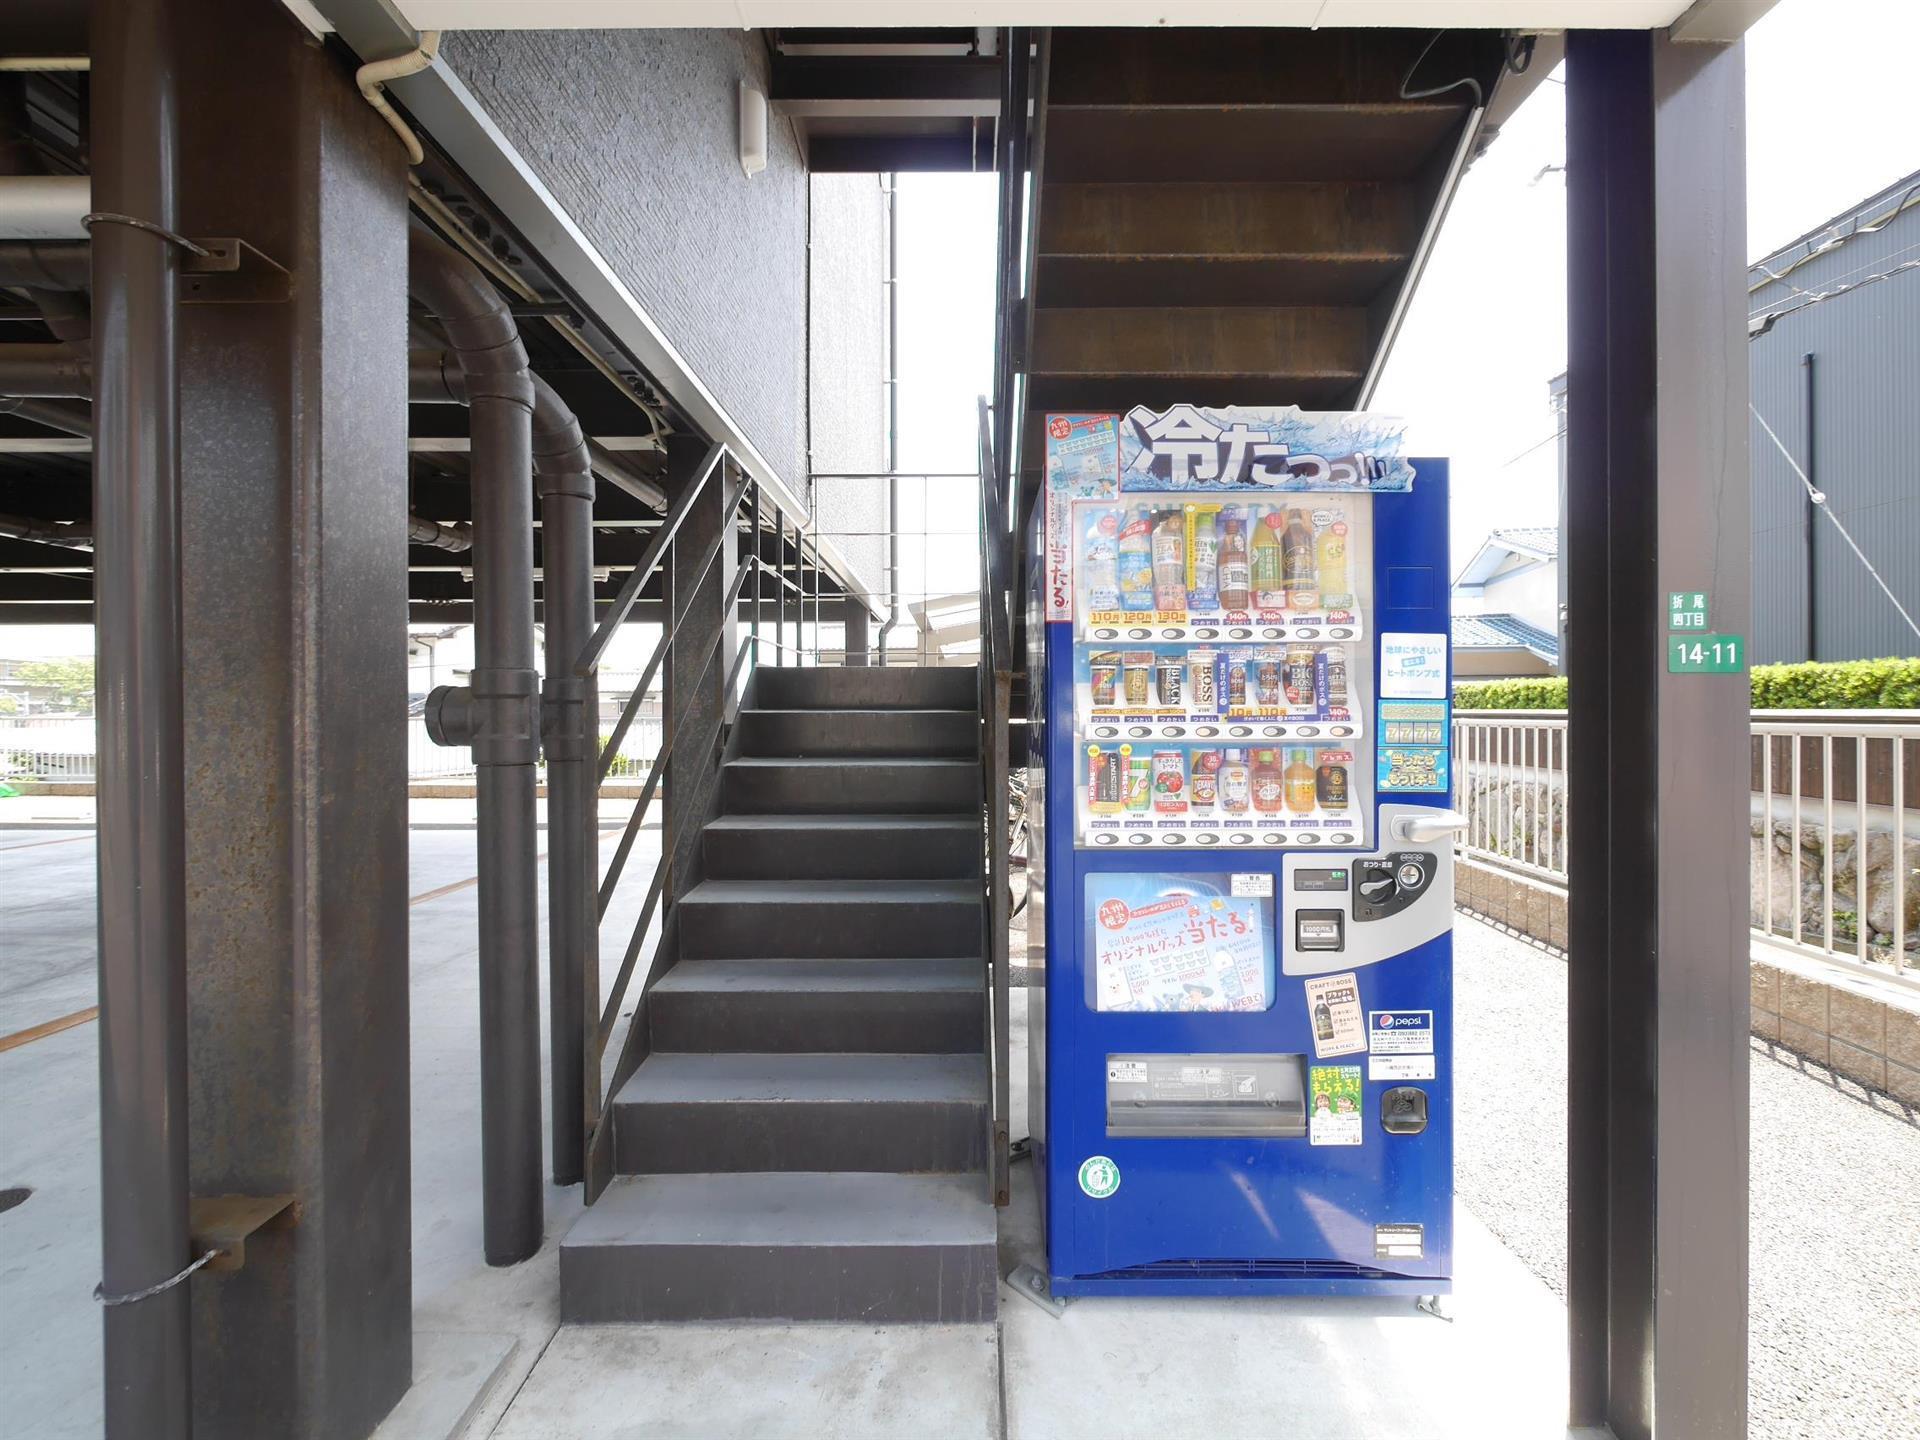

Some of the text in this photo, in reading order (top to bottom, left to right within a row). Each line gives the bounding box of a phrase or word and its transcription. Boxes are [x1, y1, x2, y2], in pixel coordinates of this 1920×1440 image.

[1672, 594, 1704, 609] 折尾
[1672, 612, 1704, 626] 四丁目
[1386, 646, 1441, 655] 地球にやさしい
[1677, 643, 1736, 664] 14-11
[1387, 669, 1441, 678] ヒートポンプ式
[1171, 668, 1181, 705] BLACK
[1202, 666, 1213, 703] BOSS
[1101, 903, 1124, 916] 九州
[1104, 914, 1127, 928] 限定
[1101, 934, 1186, 965] オリジナルグッズ
[1310, 978, 1352, 990] CRAFT BOSS
[1395, 1016, 1422, 1027] pepsi
[1312, 1067, 1340, 1080] 絶対
[1313, 1078, 1361, 1095] もらえる!
